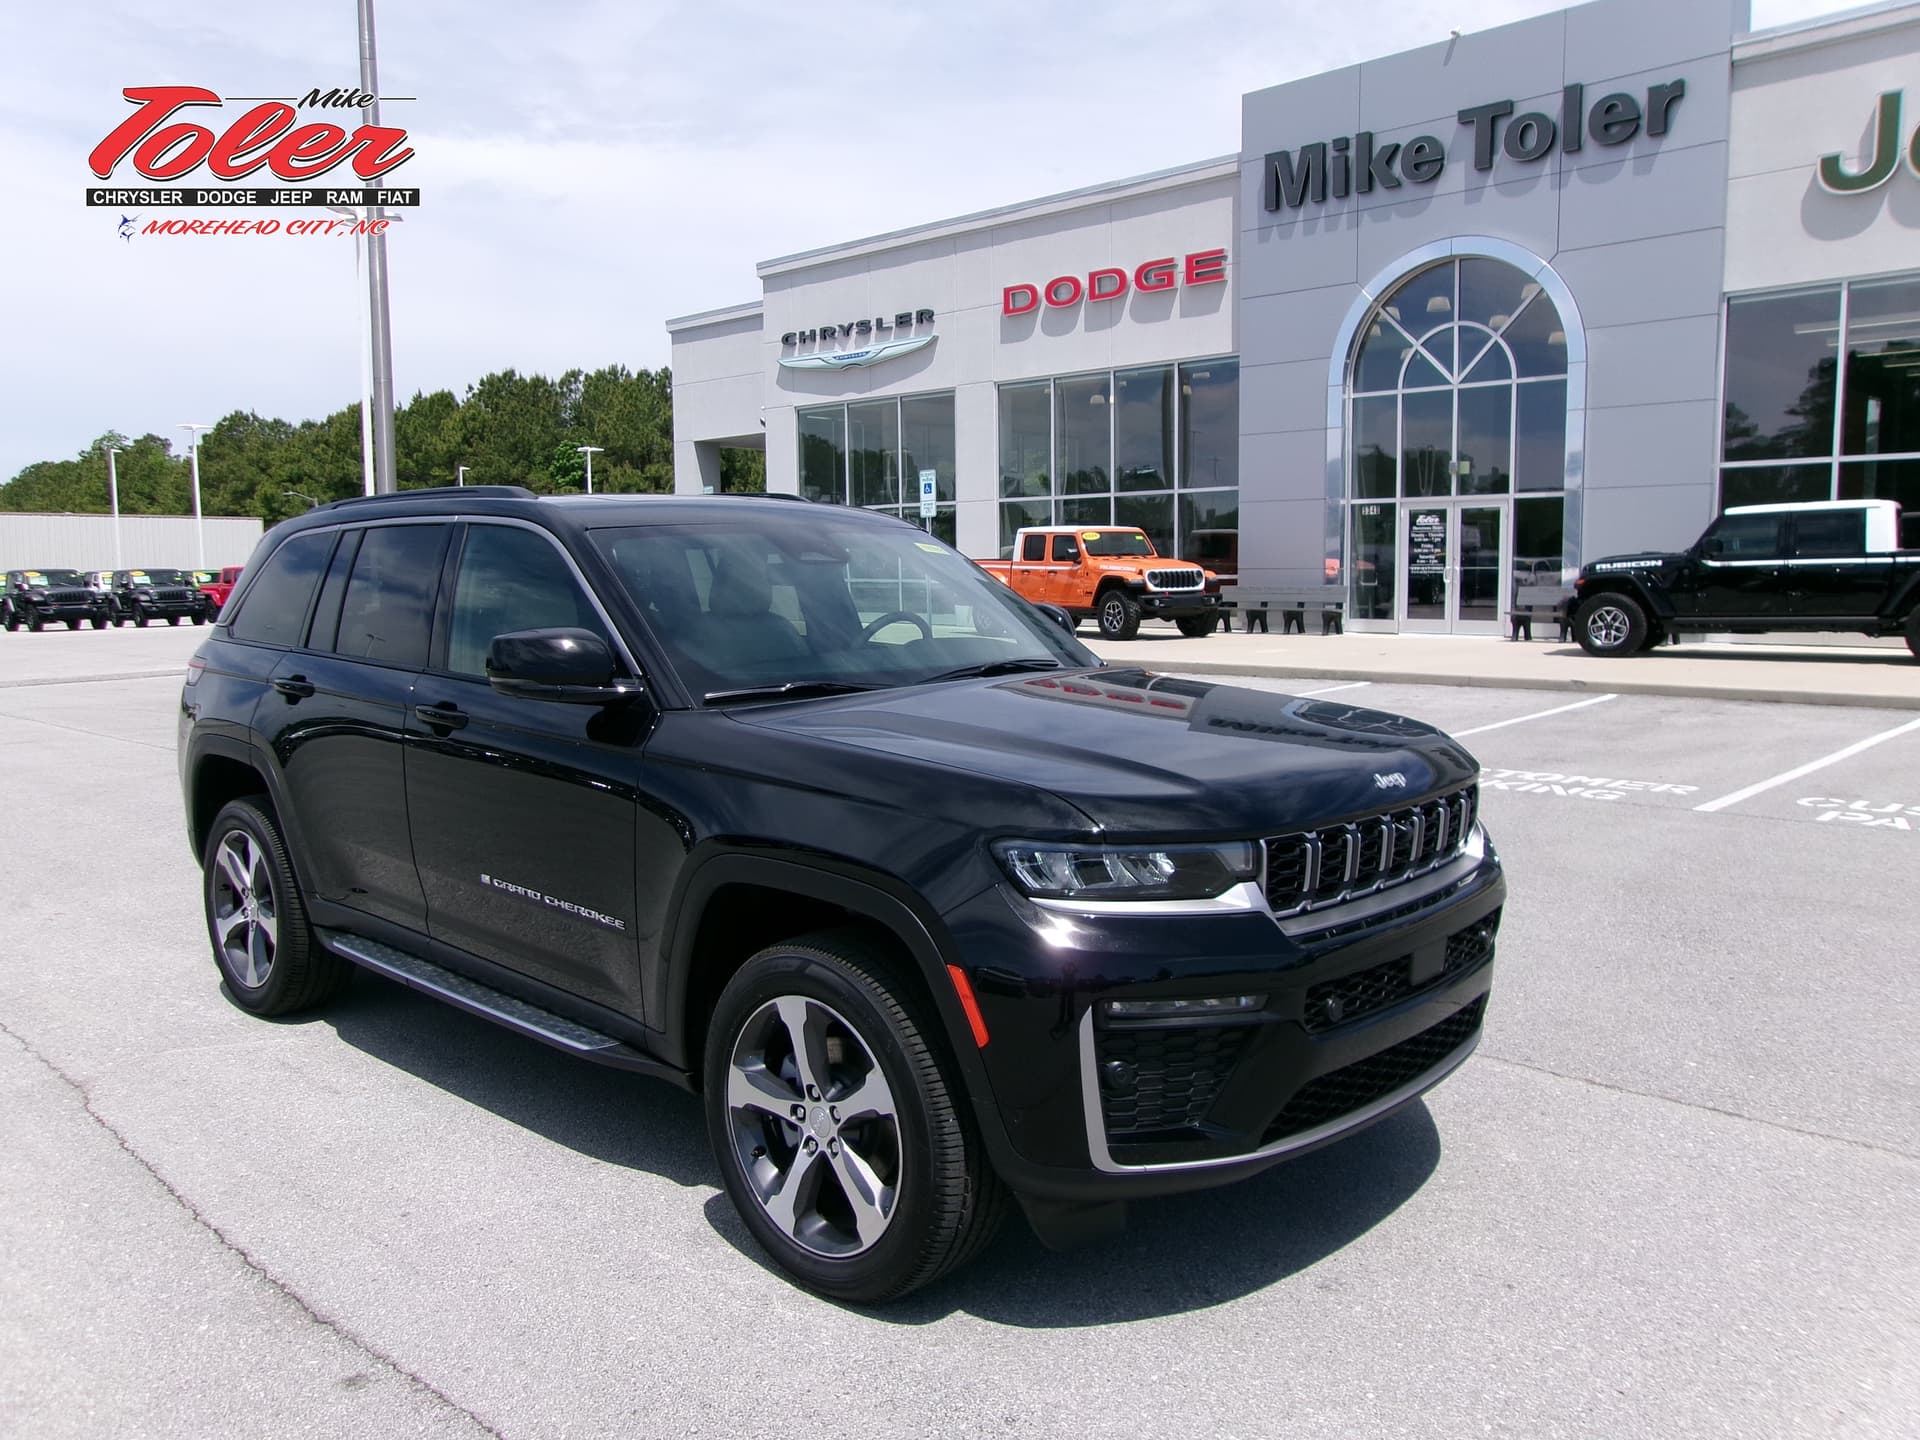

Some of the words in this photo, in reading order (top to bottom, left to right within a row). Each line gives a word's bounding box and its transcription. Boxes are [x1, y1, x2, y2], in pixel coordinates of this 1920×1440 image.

[1264, 131, 1445, 212] Mike
[1457, 77, 1686, 170] Toler
[1002, 247, 1228, 317] DODGE
[781, 308, 935, 346] CHRYSLER
[1596, 559, 1663, 571] RUBICON
[1373, 772, 1407, 789] Jeep
[1479, 778, 1627, 800] KING
[1480, 768, 1700, 795] TOMER
[493, 878, 541, 900] GRAND
[544, 895, 626, 930] CHEROKEE
